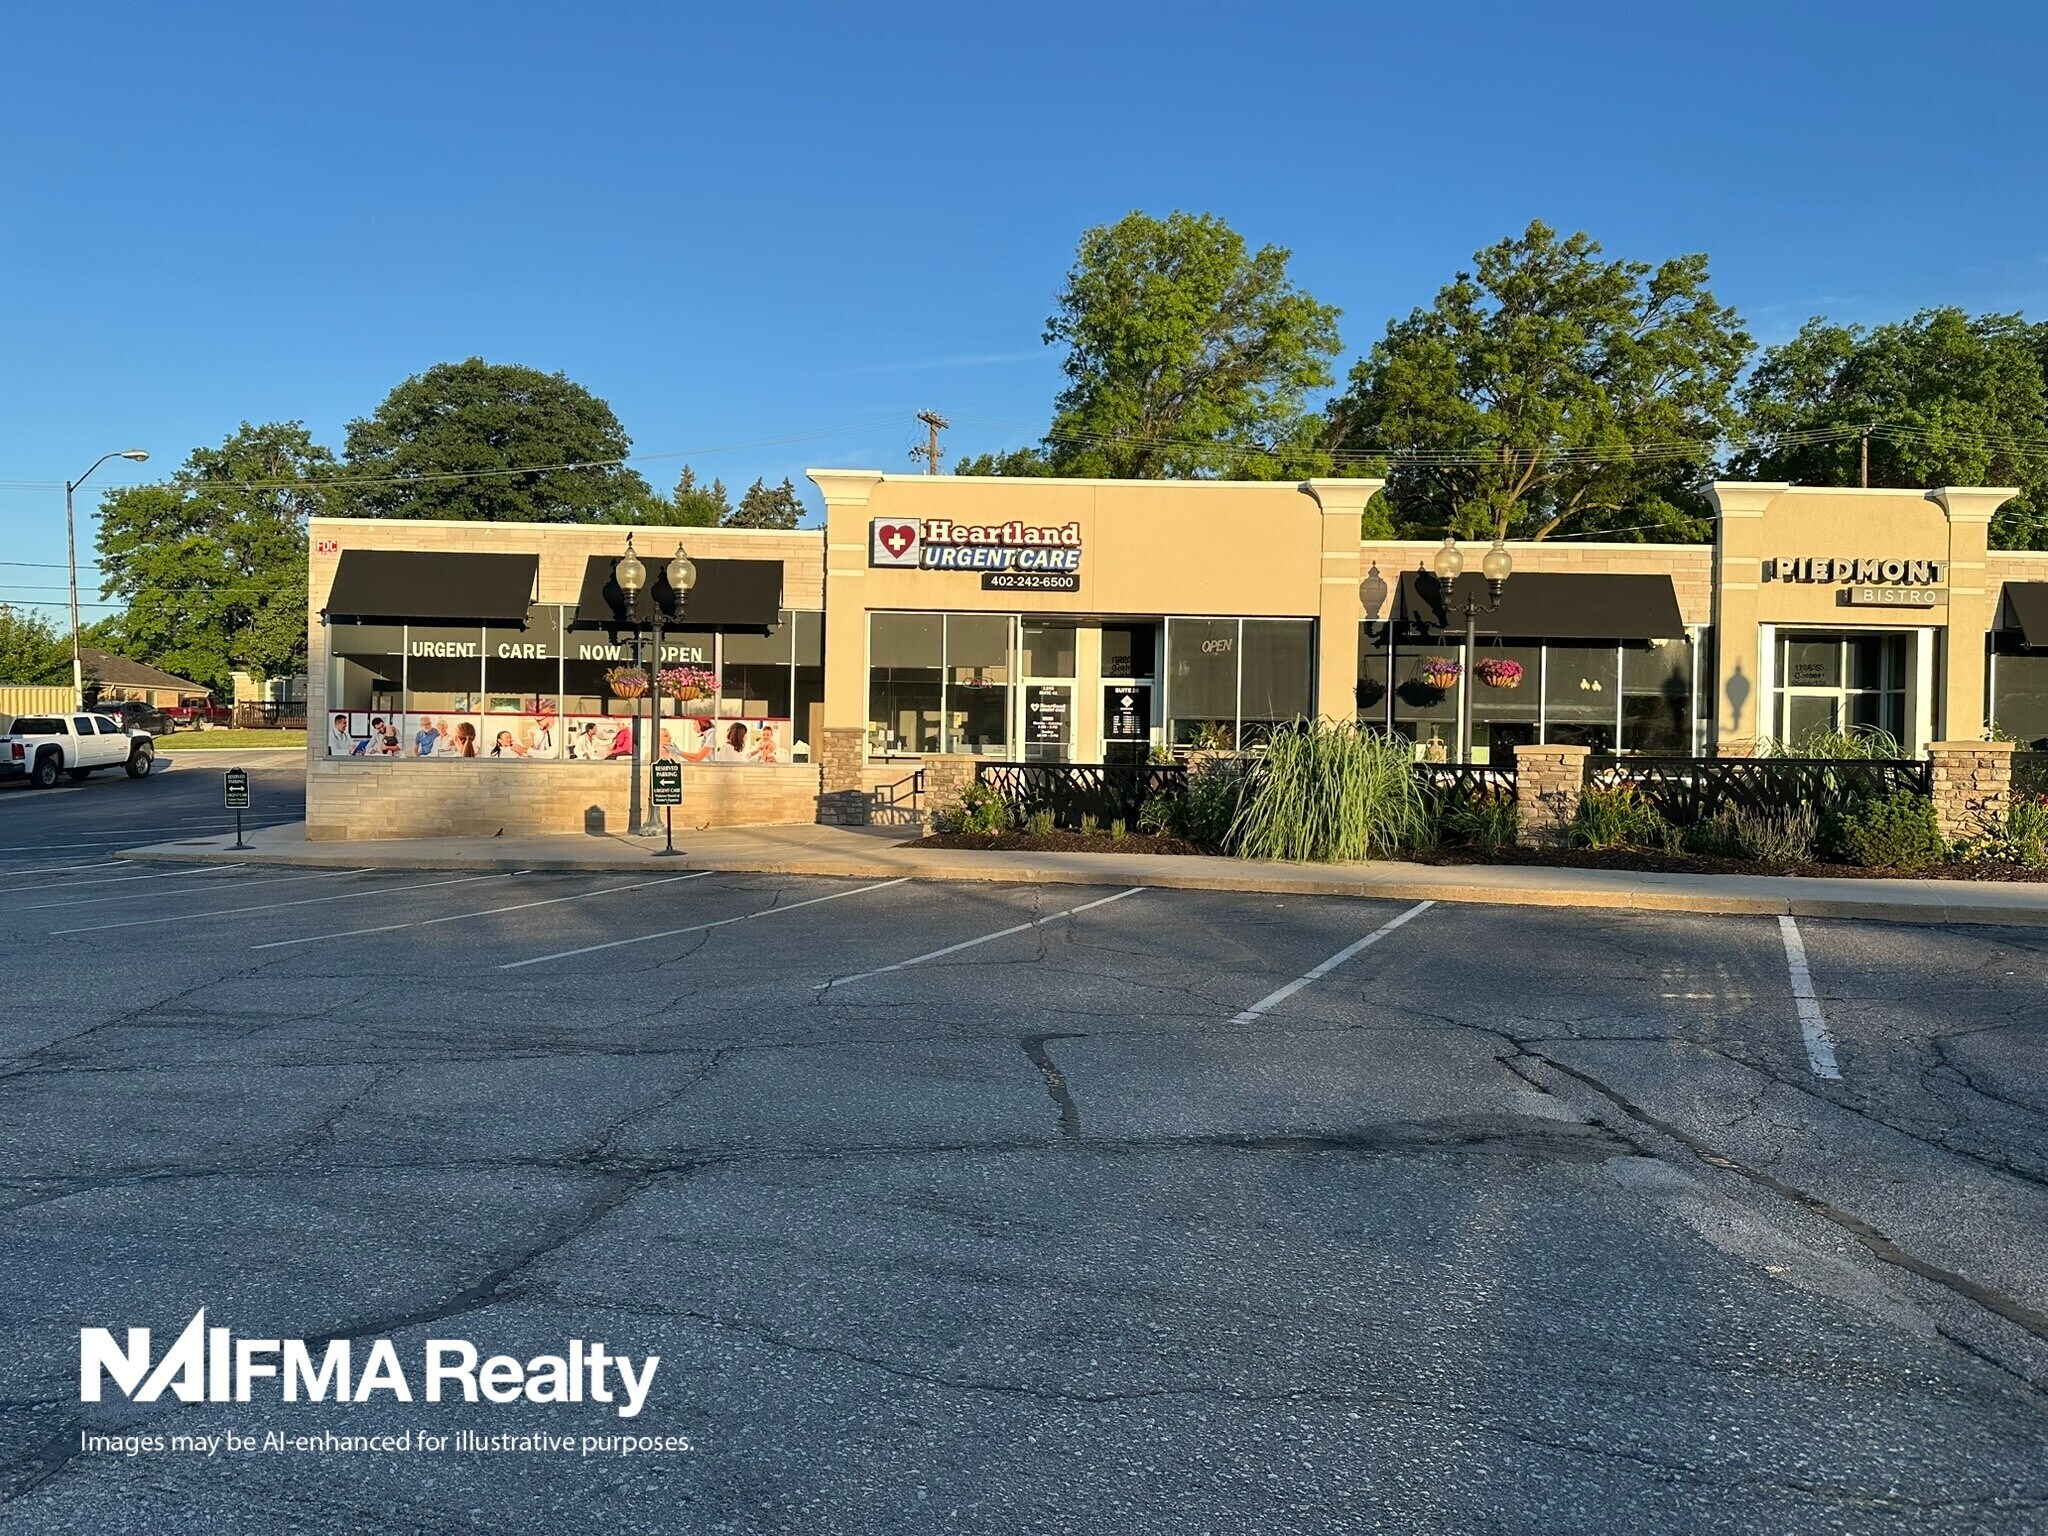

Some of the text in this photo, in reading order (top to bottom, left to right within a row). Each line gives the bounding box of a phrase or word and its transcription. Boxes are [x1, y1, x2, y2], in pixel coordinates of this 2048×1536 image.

[926, 519, 1081, 546] Heartland
[316, 540, 337, 552] FDC
[925, 548, 1081, 569] URGENT CARE
[1775, 556, 1948, 583] PIEDMONT
[990, 576, 1074, 588] 402-242-6500
[1863, 589, 1937, 603] BISTRO
[412, 641, 476, 658] URGENT
[498, 643, 547, 660] CARE
[579, 644, 621, 660] NOW
[1201, 639, 1233, 653] OPEN
